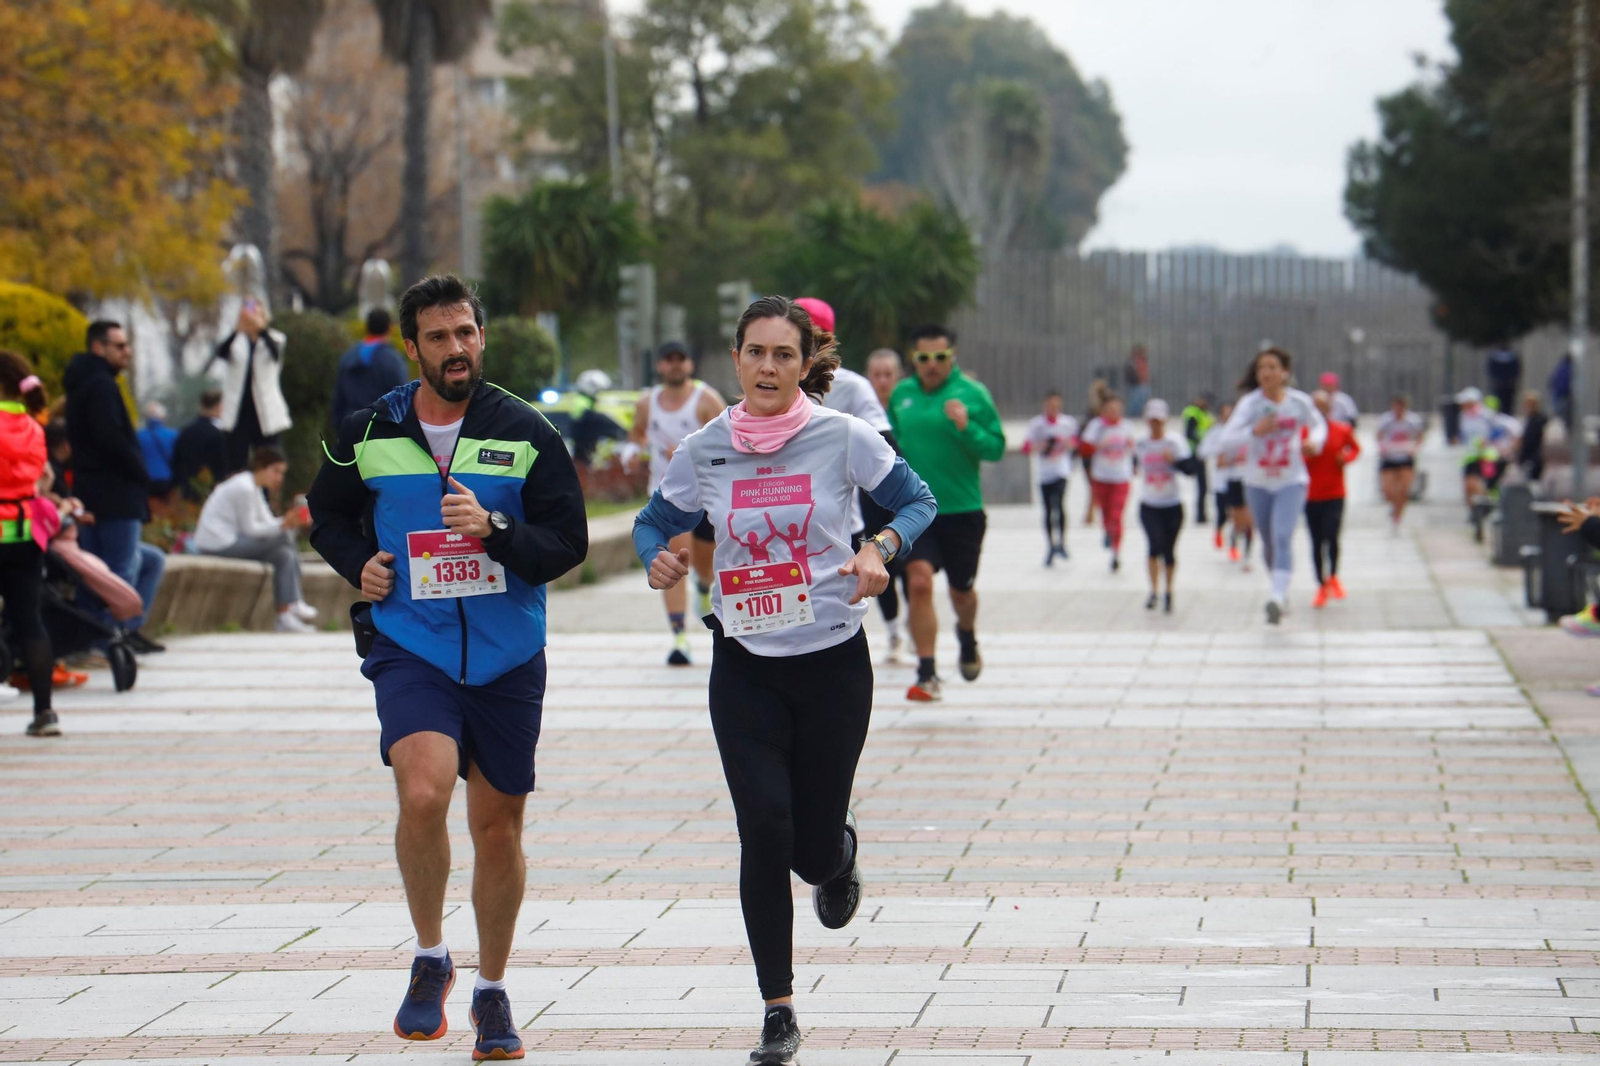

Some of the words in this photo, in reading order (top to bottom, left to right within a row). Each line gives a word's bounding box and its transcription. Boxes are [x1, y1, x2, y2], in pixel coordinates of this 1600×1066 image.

[740, 488, 761, 497] PINK
[762, 485, 802, 495] RUNNING
[779, 494, 791, 502] 100
[432, 560, 480, 583] 1333
[744, 593, 782, 617] 1707
